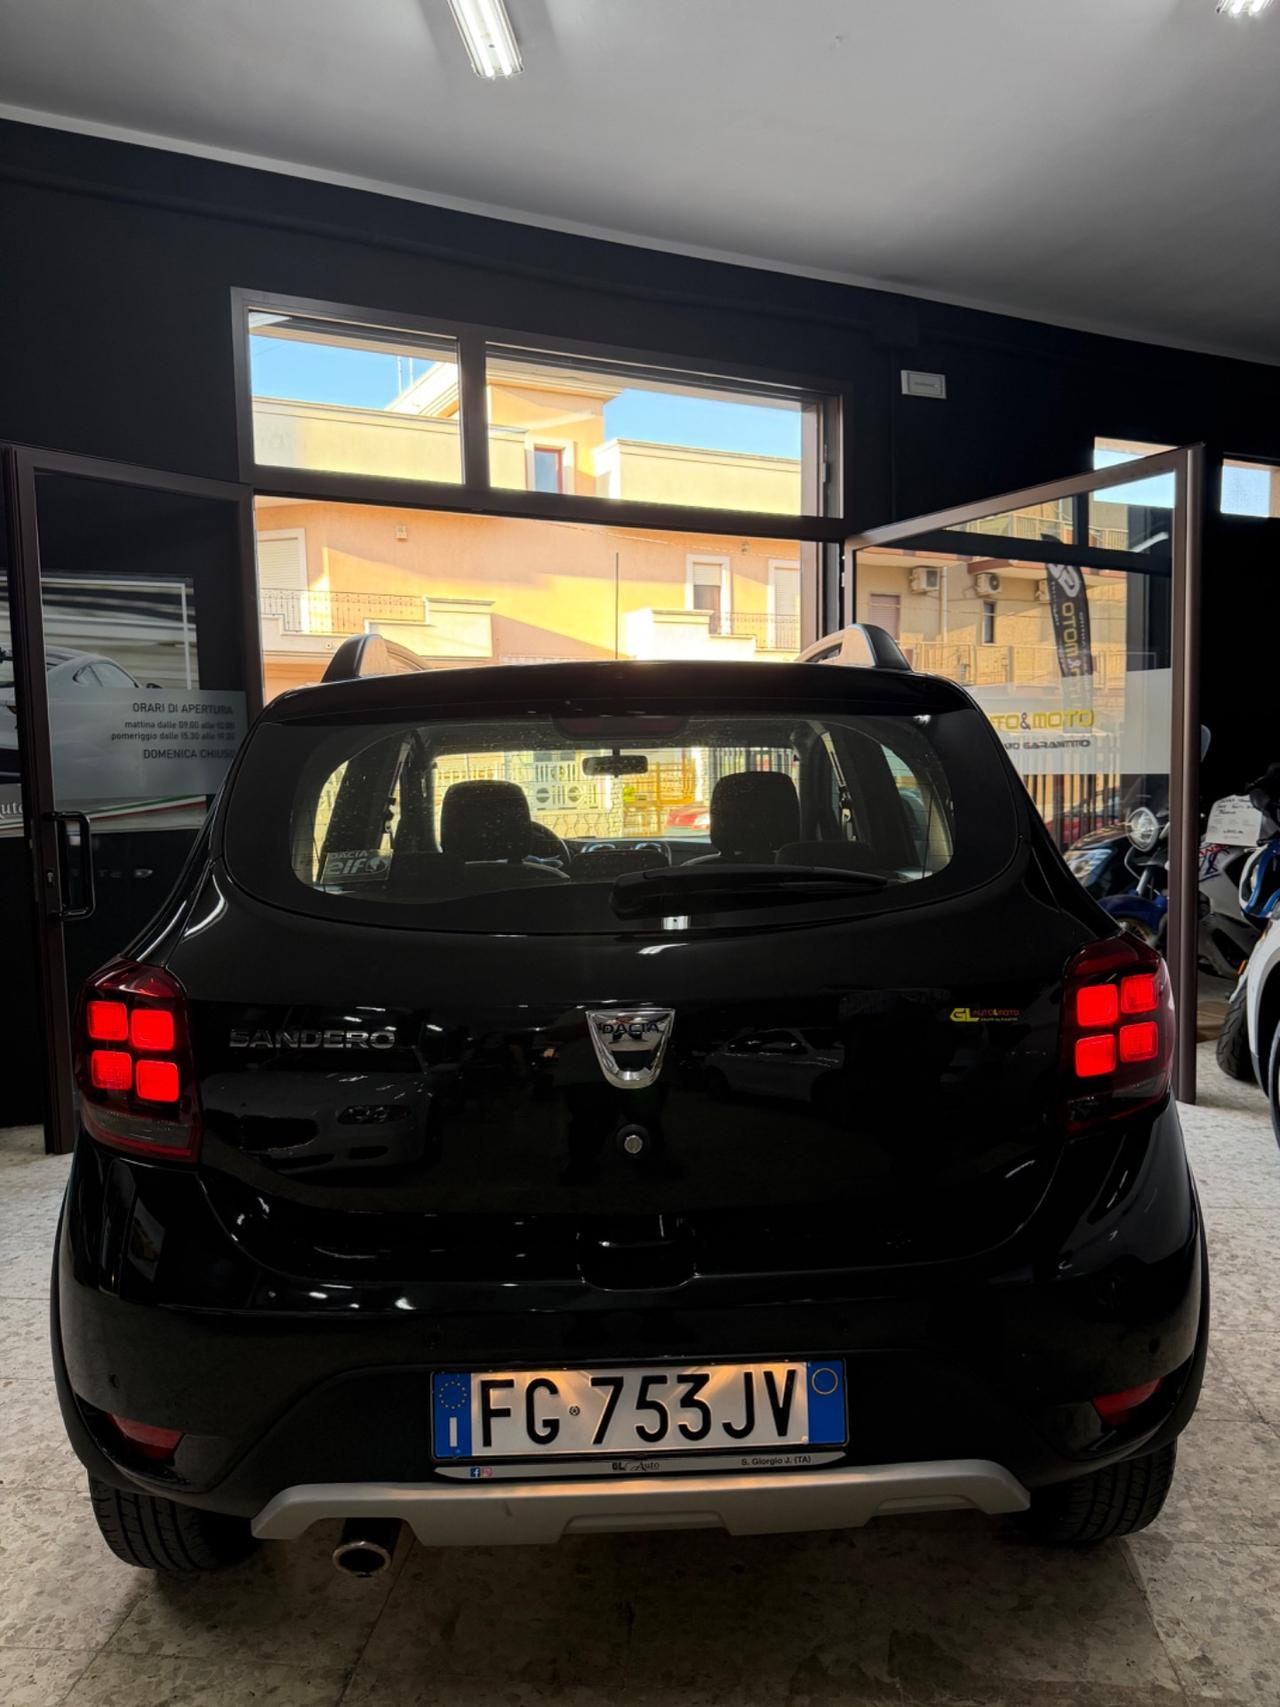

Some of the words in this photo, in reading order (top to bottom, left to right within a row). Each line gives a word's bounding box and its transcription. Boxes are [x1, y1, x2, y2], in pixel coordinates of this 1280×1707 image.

[132, 702, 165, 713] ORARI
[168, 703, 178, 713] DI
[181, 704, 234, 715] APERTURA
[124, 720, 155, 729] mattina
[157, 720, 176, 729] dalle
[989, 709, 1094, 730] TO&MOTO
[111, 732, 157, 741] pomeriggio
[160, 732, 178, 740] dalle
[143, 749, 197, 759] DOMENICA
[327, 858, 369, 875] elf
[950, 1007, 980, 1023] GL
[602, 1021, 660, 1034] DACIA
[228, 1028, 396, 1050] SANDERO
[480, 1377, 560, 1448] FG
[630, 1461, 660, 1472] Auto
[740, 1458, 750, 1466] S.
[752, 1457, 784, 1466] Giorgio
[784, 1456, 793, 1464] J.
[794, 1455, 812, 1464] (TA)
